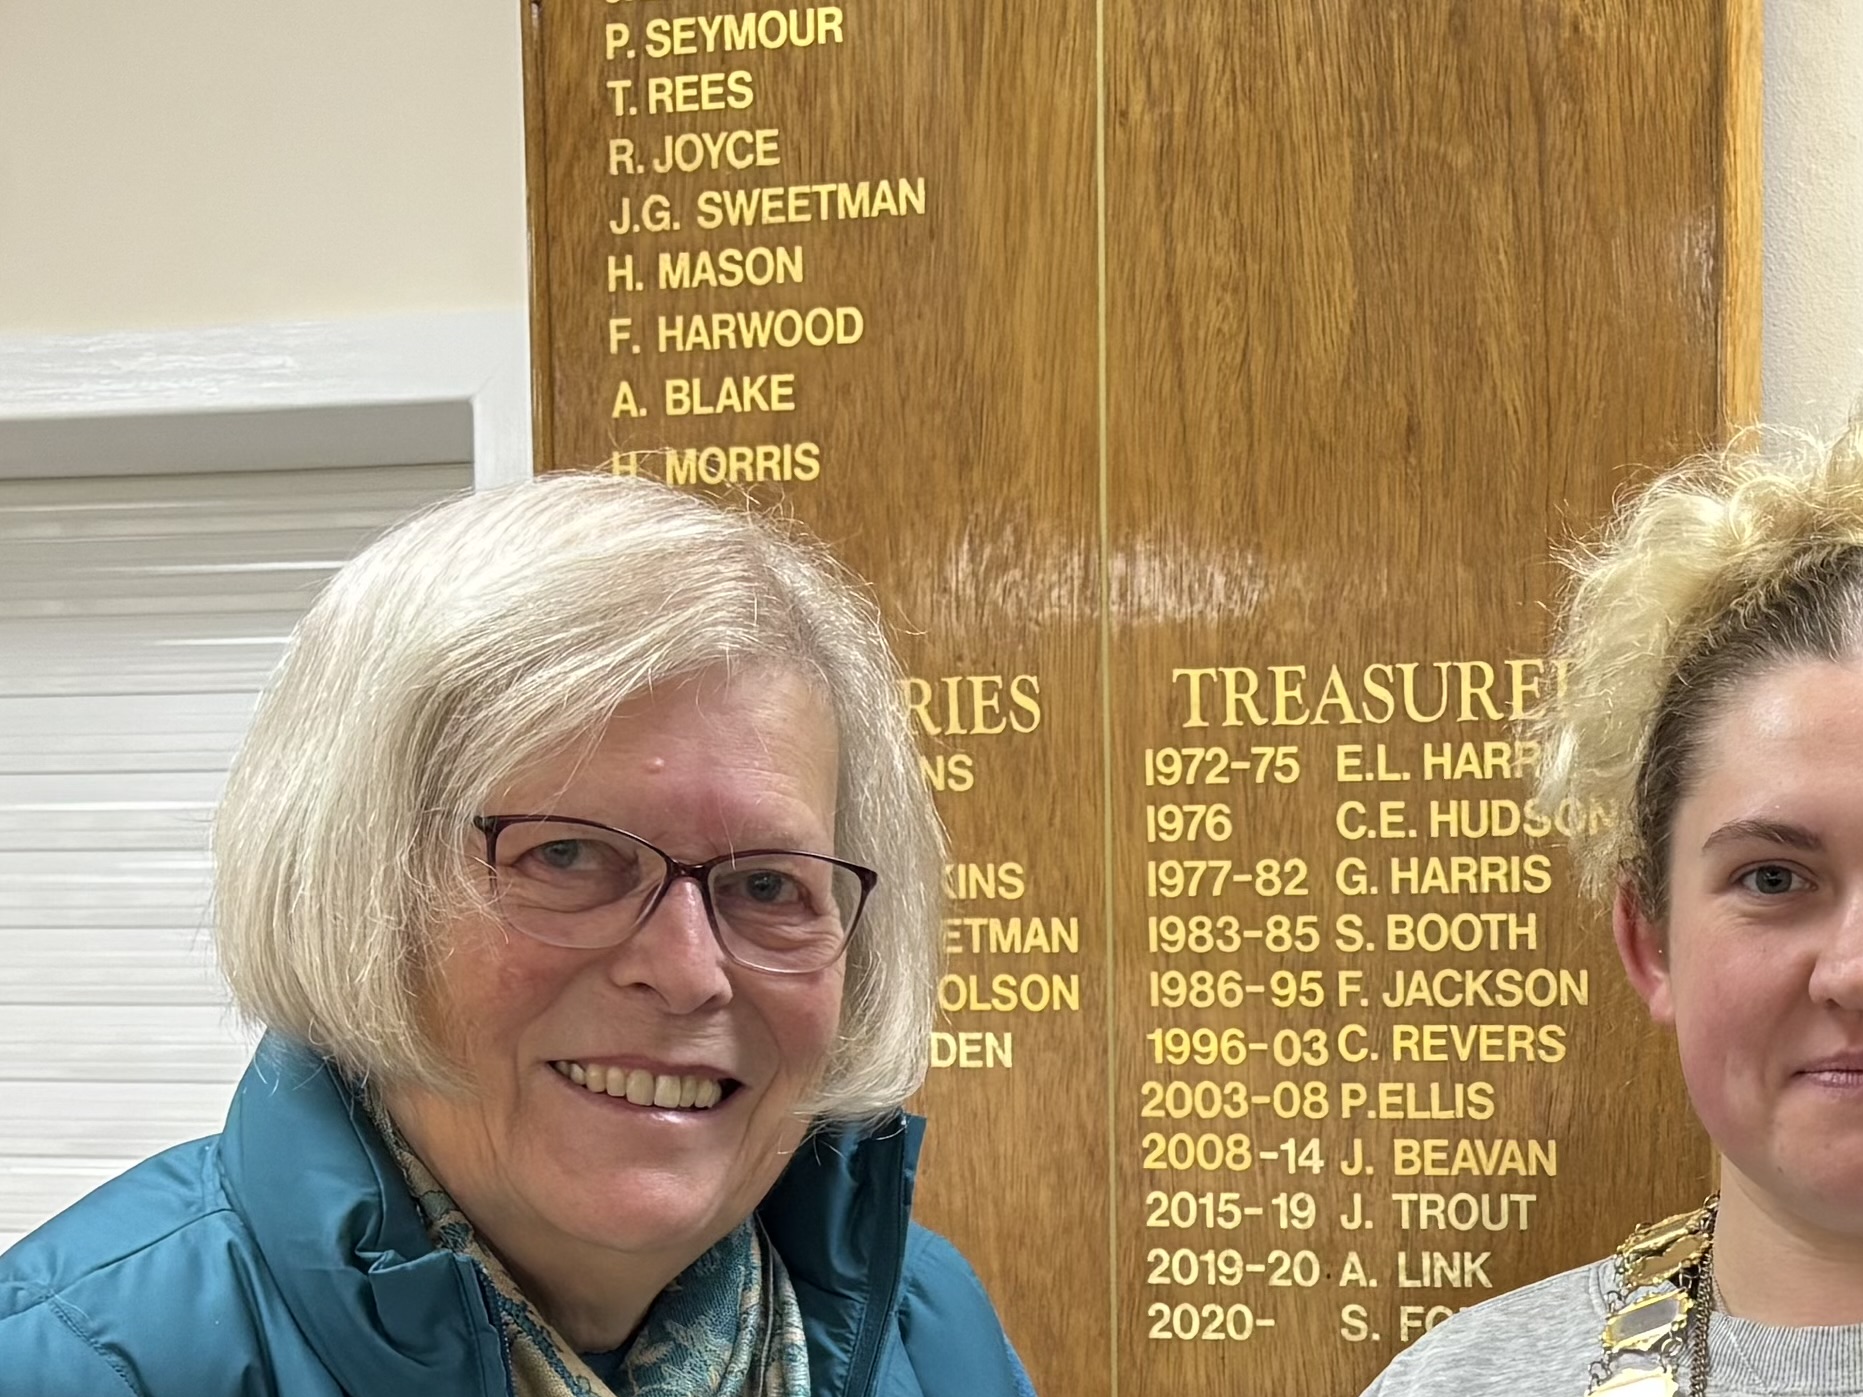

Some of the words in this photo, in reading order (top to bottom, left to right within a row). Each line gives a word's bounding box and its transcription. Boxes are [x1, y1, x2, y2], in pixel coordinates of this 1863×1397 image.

[605, 22, 636, 60] P.
[645, 6, 844, 58] SEYMOUR
[606, 79, 637, 116] T.
[648, 70, 754, 115] REES
[609, 138, 644, 176] R.
[653, 128, 781, 173] JOYCE
[609, 194, 681, 235] J.G.
[697, 177, 926, 229] SWEETMAN
[608, 254, 644, 292] H.
[658, 245, 803, 290] MASON
[609, 318, 641, 354] F.
[658, 306, 864, 353] HARWOOD
[612, 381, 647, 418] A.
[665, 373, 795, 416] BLAKE
[665, 442, 821, 487] MORRIS
[898, 674, 1041, 736] RIES
[1172, 659, 1572, 728] TREASURE
[920, 753, 975, 792] NS
[1145, 745, 1300, 786] 1972-75
[1337, 743, 1411, 782] E.L.
[1424, 741, 1543, 780] HARR
[1146, 803, 1233, 843] 1976
[1336, 800, 1417, 840] C.E.
[1147, 857, 1309, 898] 1977-82
[1335, 857, 1378, 896] G.
[1391, 854, 1552, 895] HARRIS
[944, 917, 1079, 954] ETMAN
[1148, 914, 1320, 953] 1983-85
[1335, 913, 1375, 952] S.
[1387, 912, 1537, 952] BOOTH
[938, 973, 1080, 1012] OLSON
[1150, 969, 1325, 1008] 1986-95
[1338, 970, 1369, 1007] F.
[1382, 968, 1588, 1008] JACKSON
[930, 1032, 1013, 1068] DEN
[1146, 1027, 1329, 1067] 1996-03
[1337, 1023, 1379, 1063] C.
[1392, 1024, 1566, 1063] REVERS
[1141, 1080, 1329, 1119] 2003-08
[1340, 1138, 1374, 1176] J.
[1393, 1138, 1557, 1177] BEAVAN
[1145, 1190, 1316, 1230] 2015-19
[1340, 1192, 1374, 1230] J.
[1391, 1192, 1537, 1231] TROUT
[1147, 1247, 1320, 1287] 2019-20
[1339, 1251, 1378, 1288] A.
[1398, 1251, 1493, 1288] LINK
[1147, 1302, 1276, 1341] 2020-
[1340, 1303, 1380, 1342] S.
[1400, 1305, 1468, 1342] FO
